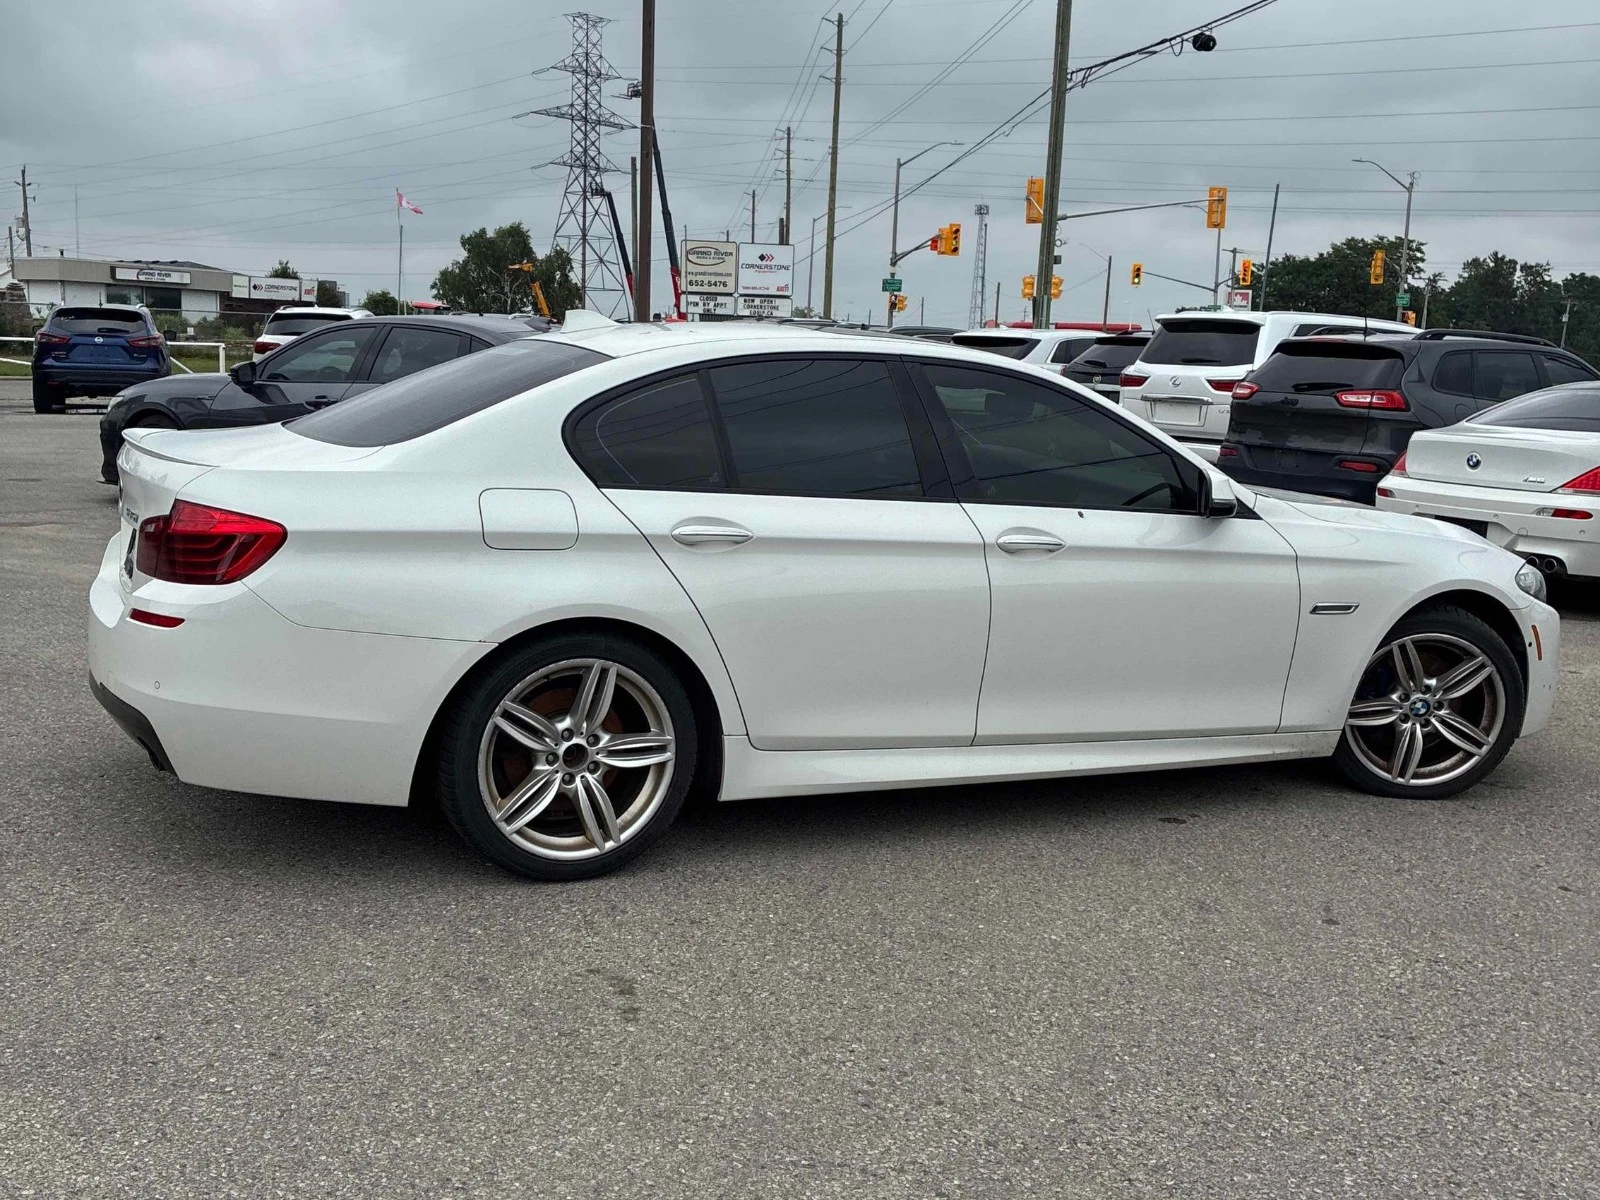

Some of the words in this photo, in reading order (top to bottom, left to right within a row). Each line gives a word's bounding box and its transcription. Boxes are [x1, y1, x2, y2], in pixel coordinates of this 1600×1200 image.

[741, 263, 791, 271] CORNERSTONE
[264, 284, 298, 292] CORNERSTONE
[688, 280, 728, 288] 652-5476
